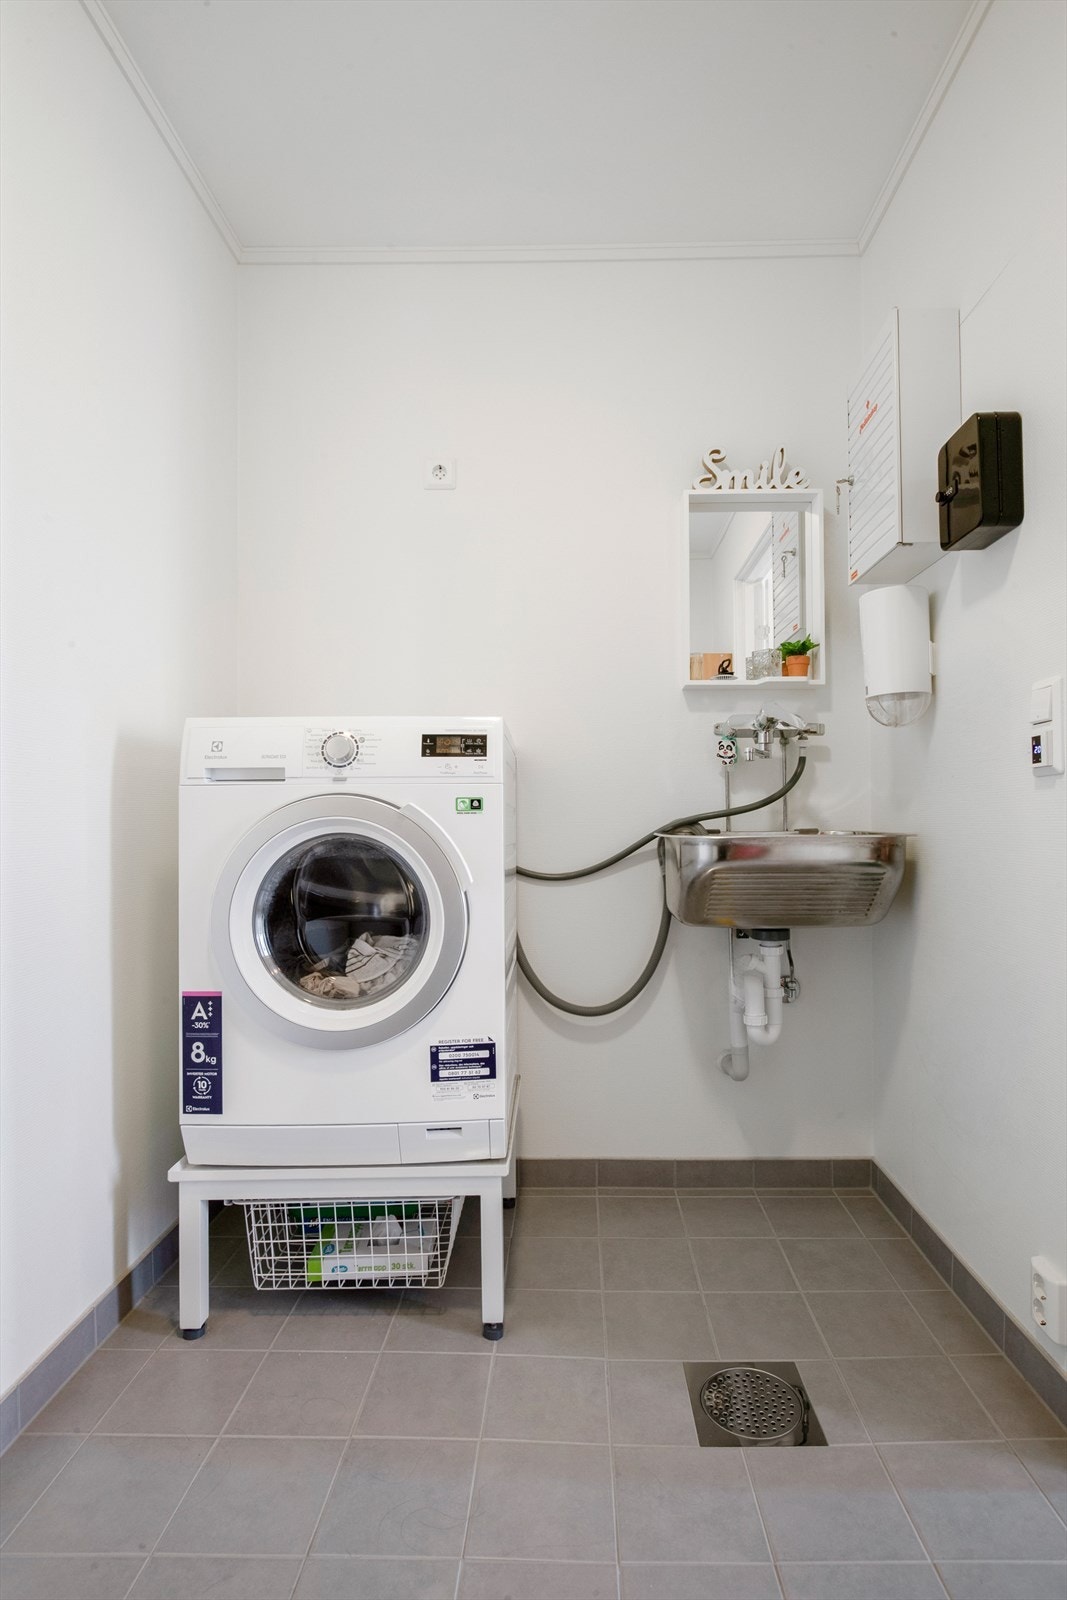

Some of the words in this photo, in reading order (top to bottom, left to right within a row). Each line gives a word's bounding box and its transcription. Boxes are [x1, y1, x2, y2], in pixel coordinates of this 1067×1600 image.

[692, 447, 811, 490] Smile
[197, 1080, 208, 1089] 10
[391, 1262, 401, 1270] 30
